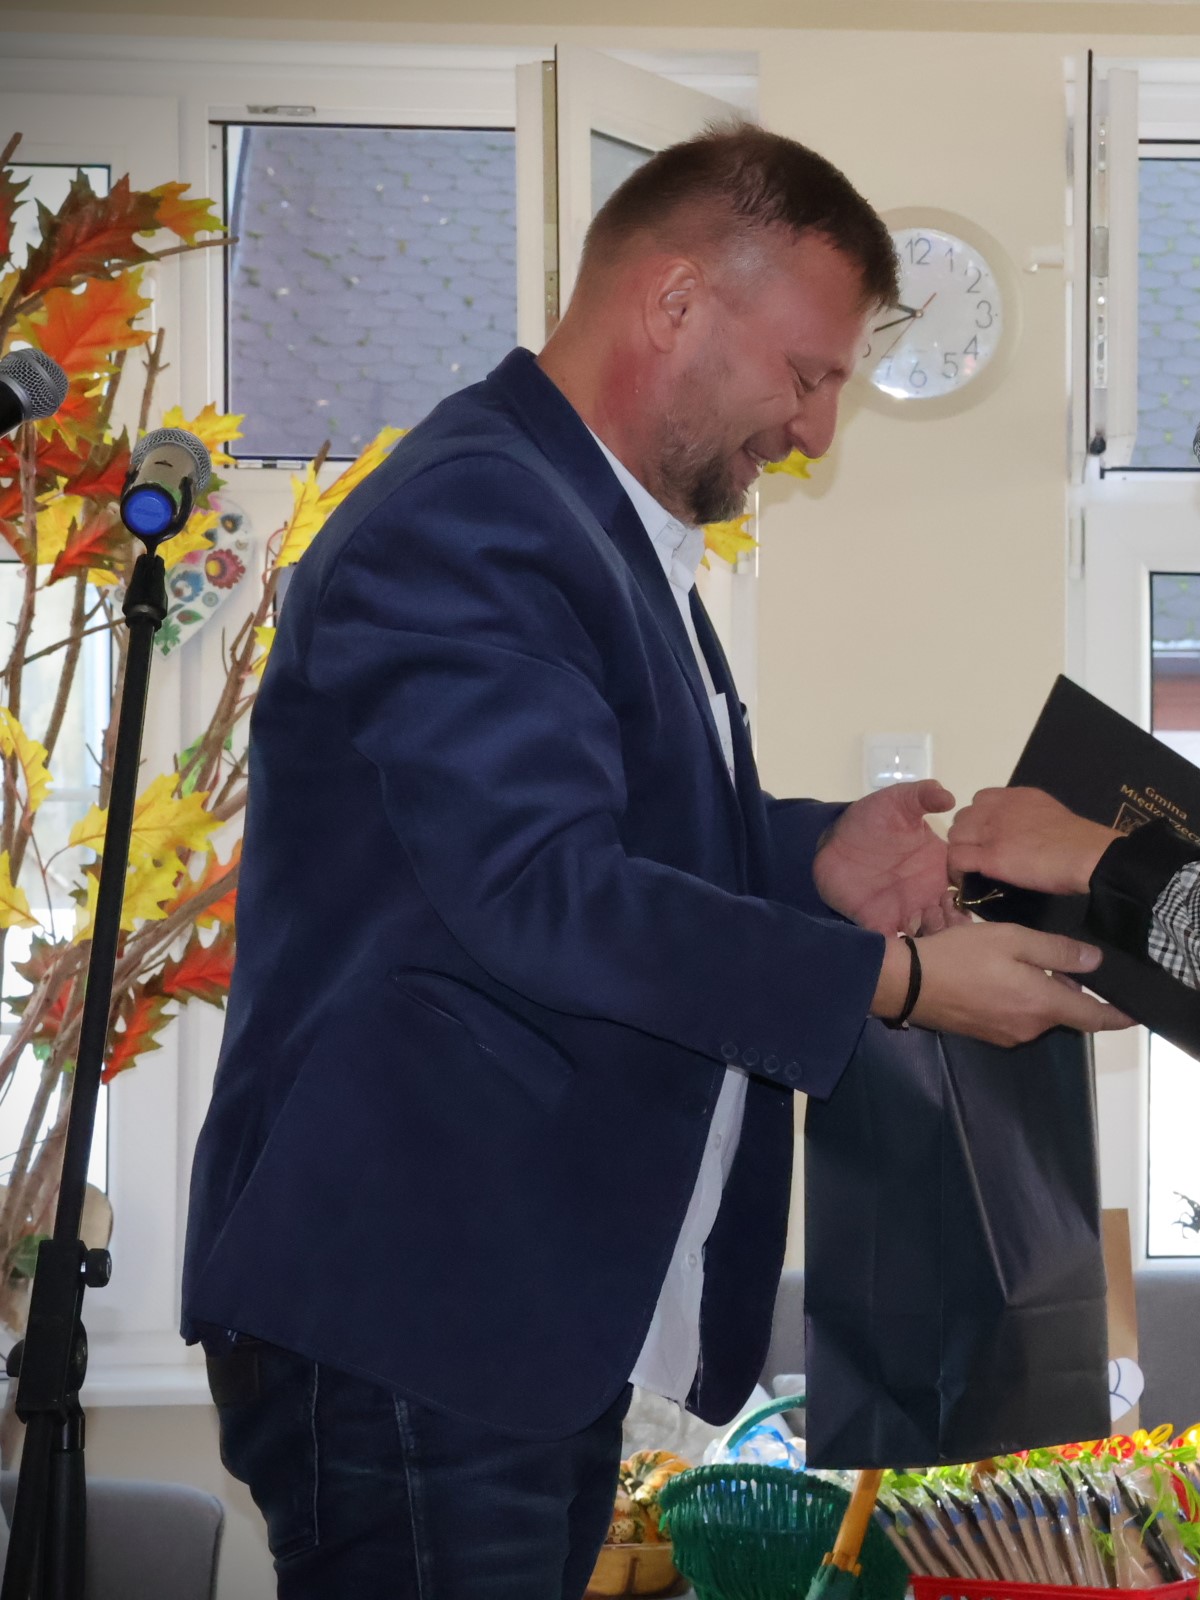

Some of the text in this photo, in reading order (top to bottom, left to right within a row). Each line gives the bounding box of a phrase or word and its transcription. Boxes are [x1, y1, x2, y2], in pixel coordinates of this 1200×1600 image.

[905, 237, 932, 265] 12
[945, 247, 954, 273] 1
[964, 267, 982, 294] 2
[975, 300, 993, 329] 3
[963, 335, 979, 361] 4
[909, 361, 928, 388] 6
[941, 352, 959, 379] 5
[1145, 787, 1187, 820] Gmina
